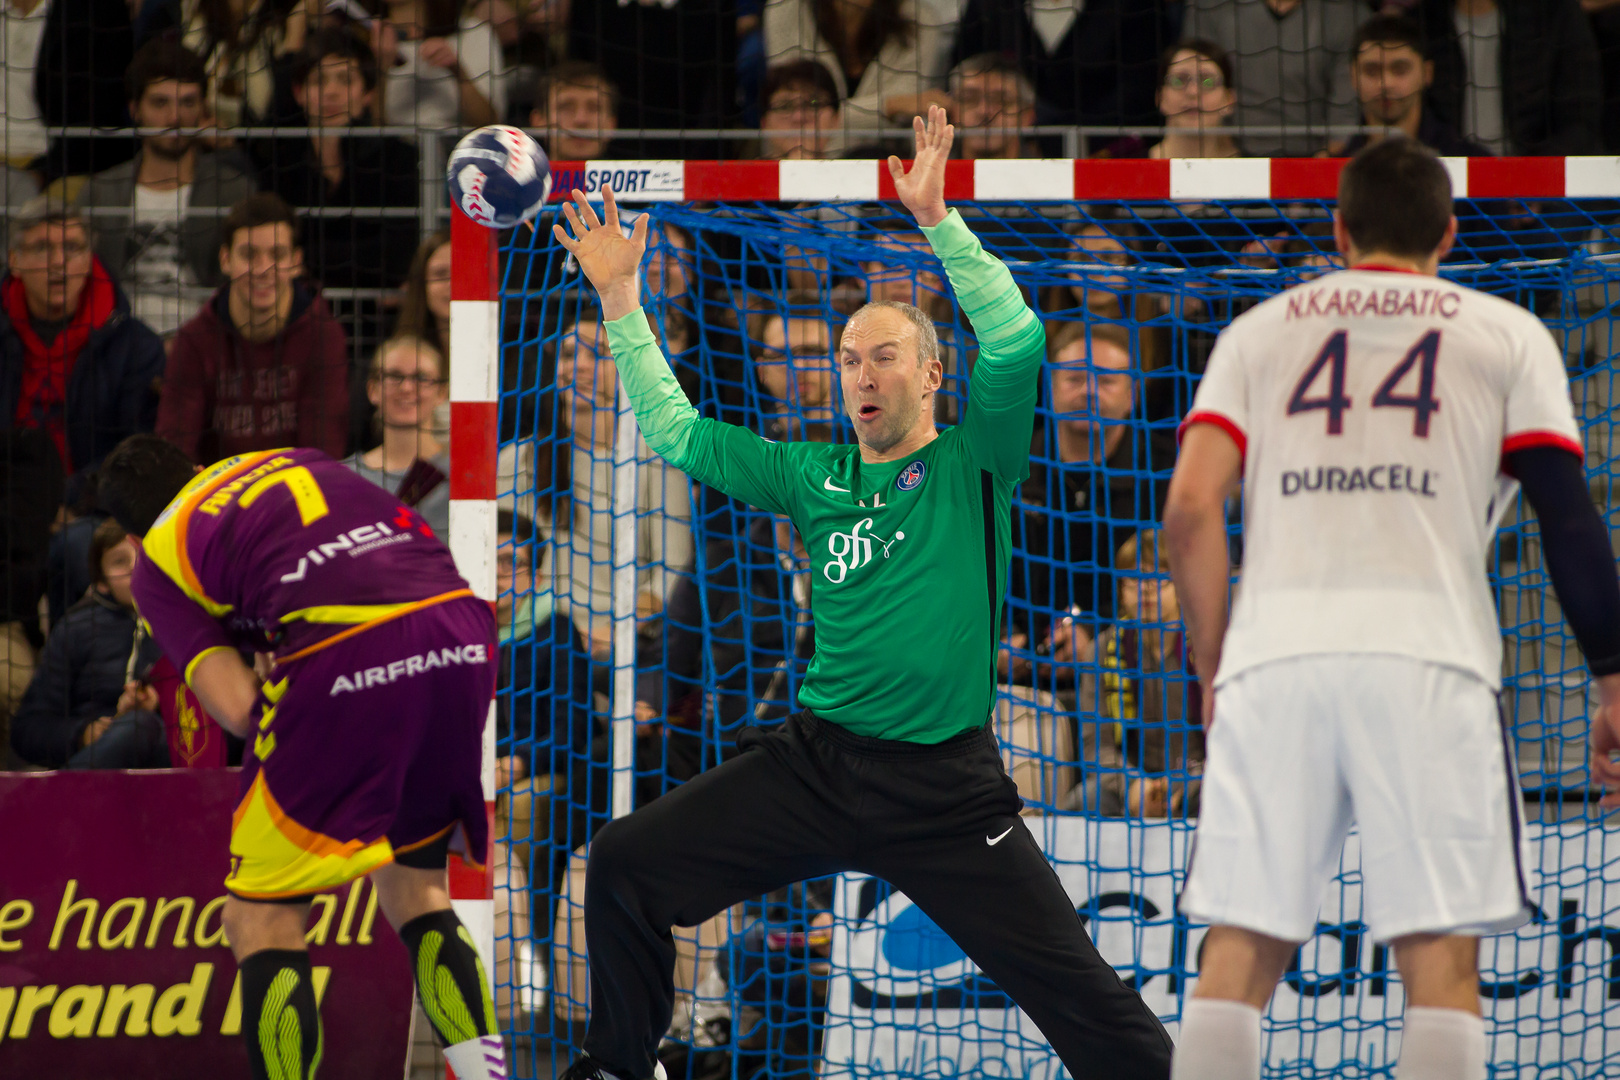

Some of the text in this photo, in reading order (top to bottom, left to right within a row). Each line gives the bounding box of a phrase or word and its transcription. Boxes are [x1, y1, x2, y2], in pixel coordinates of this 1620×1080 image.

[1286, 286, 1461, 322] N.KARABATIC
[1285, 326, 1443, 439] 44
[238, 464, 329, 526] 7
[1281, 464, 1438, 498] DURACELL
[280, 521, 394, 583] VINCI
[0, 962, 215, 1045] rand
